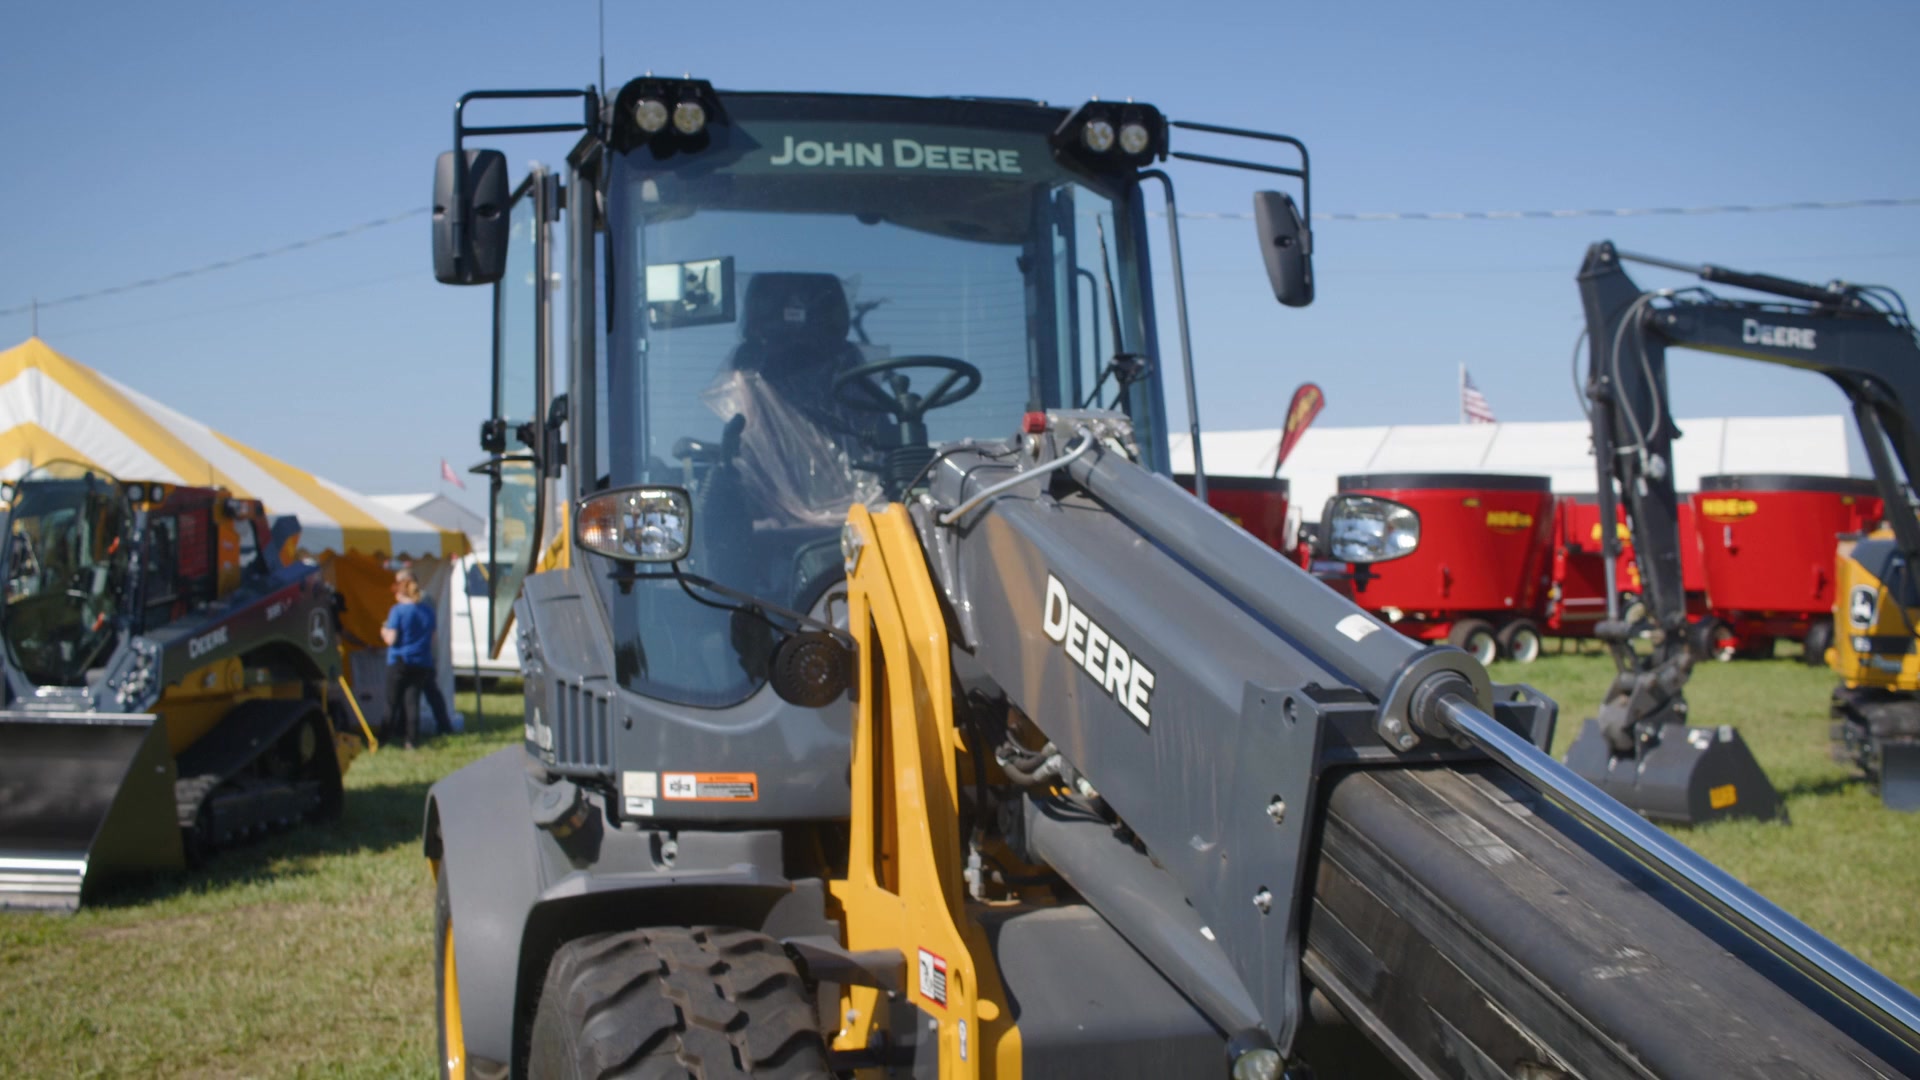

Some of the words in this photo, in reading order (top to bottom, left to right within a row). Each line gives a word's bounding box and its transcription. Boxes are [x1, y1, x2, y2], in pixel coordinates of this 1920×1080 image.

[771, 136, 883, 168] JOHN
[892, 139, 1022, 174] DEERE
[1043, 573, 1155, 728] DEERE
